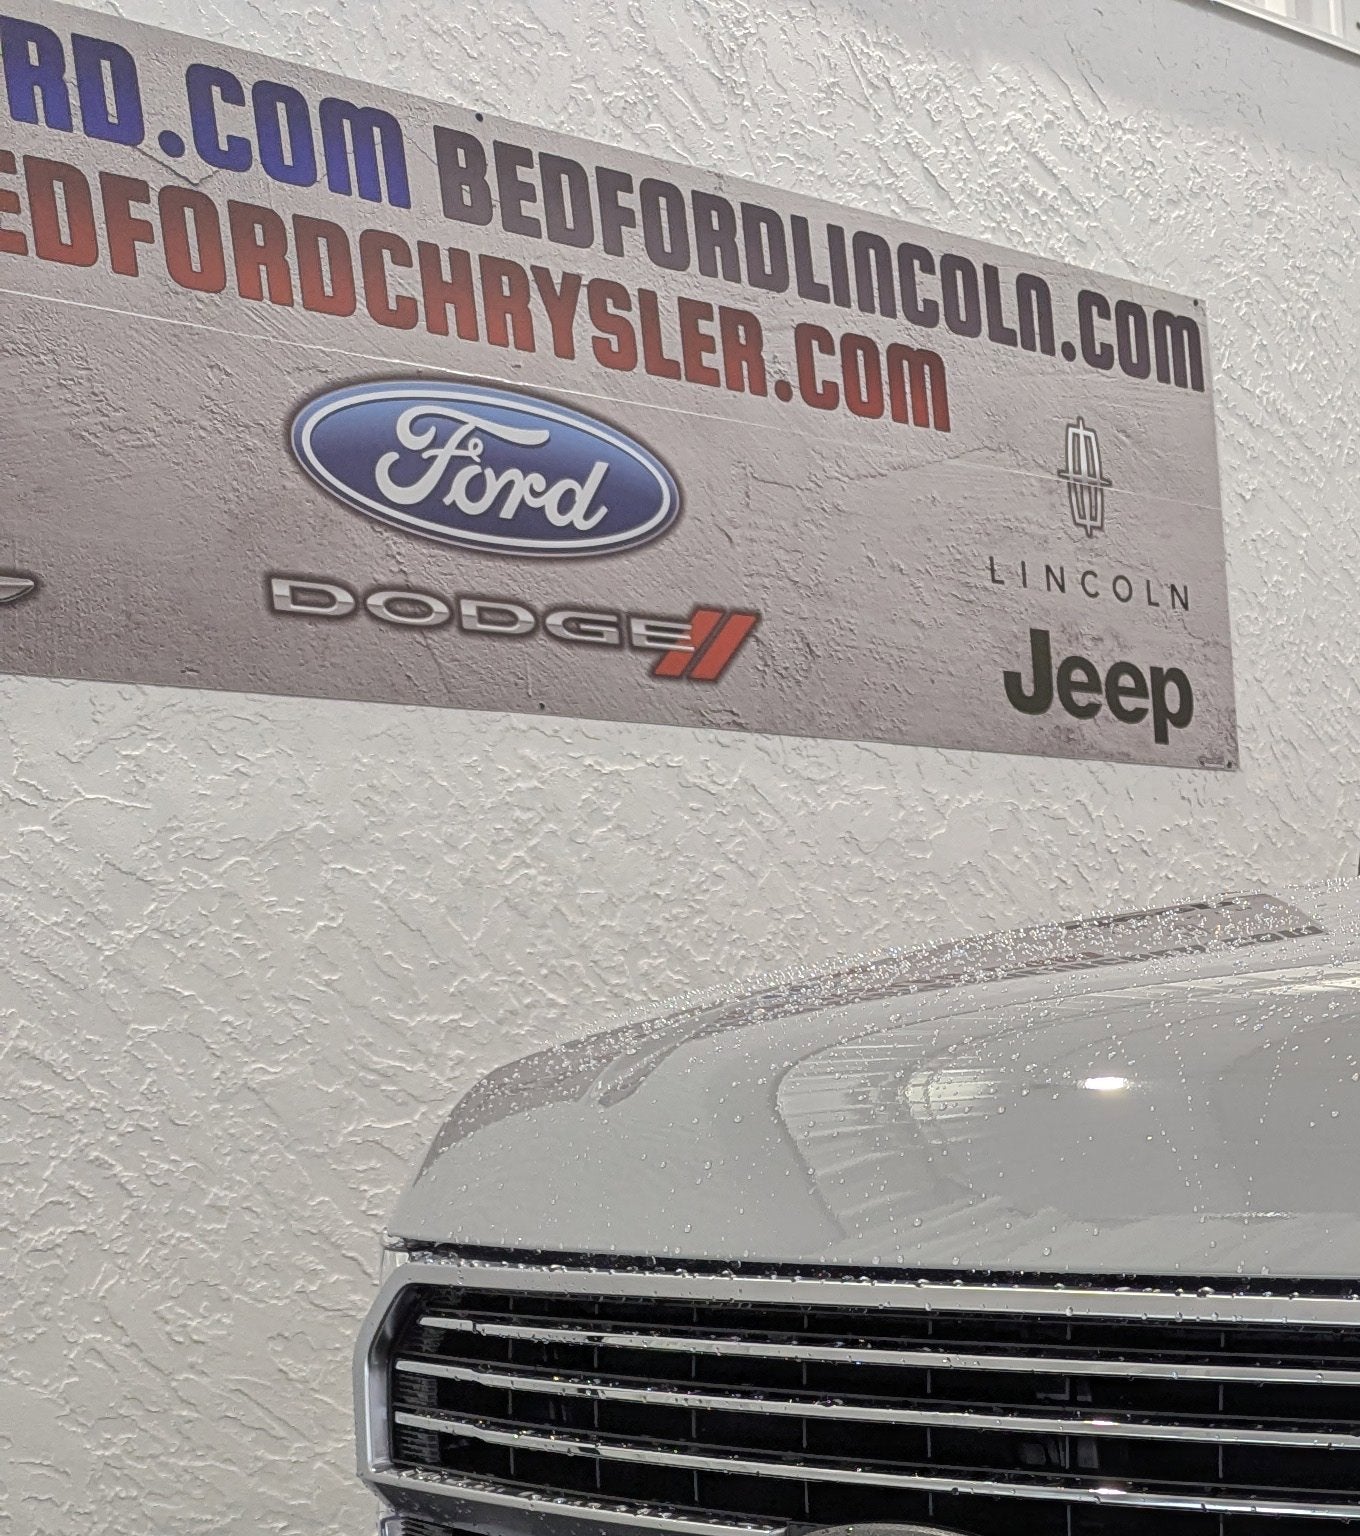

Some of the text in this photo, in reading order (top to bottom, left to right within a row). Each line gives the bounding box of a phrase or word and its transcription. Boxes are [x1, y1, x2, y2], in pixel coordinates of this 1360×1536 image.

[433, 125, 1205, 392] BEDFORDLINCOLN.COM
[375, 405, 609, 531] Ford
[271, 577, 696, 654] DODGE
[989, 555, 1189, 611] LINCOLN
[1003, 628, 1195, 745] Jeep
